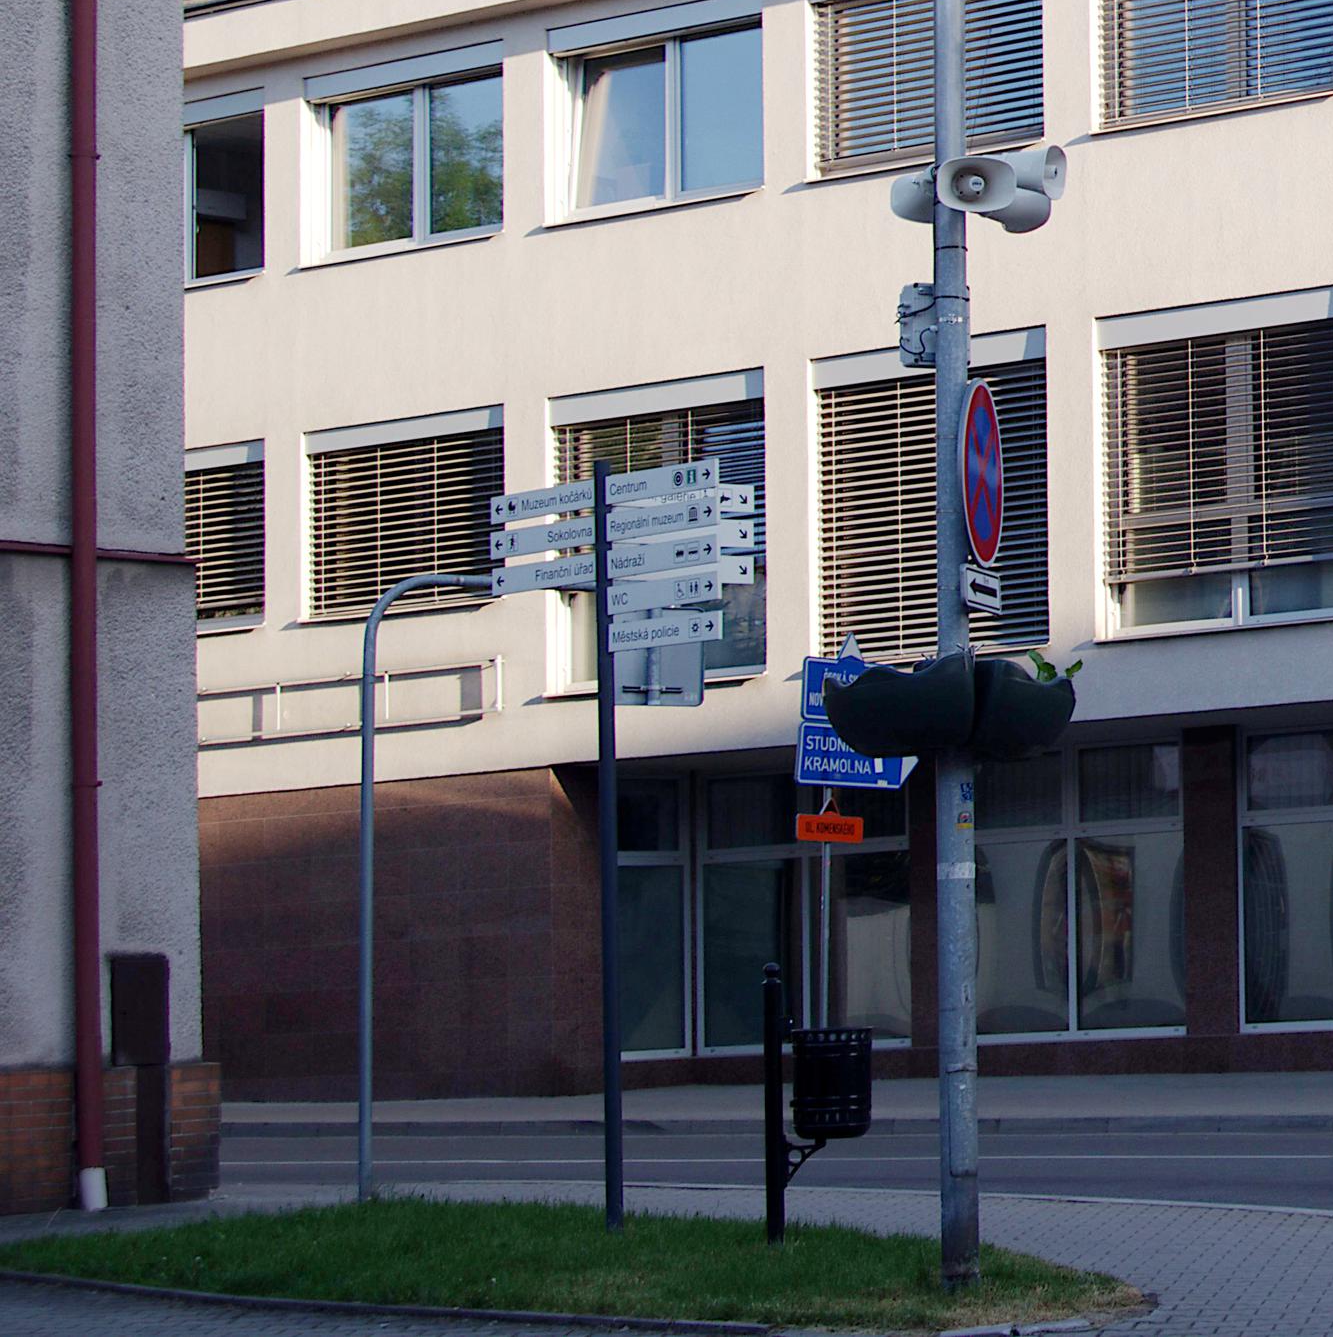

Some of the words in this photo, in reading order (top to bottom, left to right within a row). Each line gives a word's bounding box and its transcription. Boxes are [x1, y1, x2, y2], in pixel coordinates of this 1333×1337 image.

[609, 479, 648, 496] Centrum
[521, 496, 558, 512] Muzeum
[559, 487, 593, 504] kočárků
[610, 517, 650, 535] Regionální
[651, 511, 684, 527] muzeum
[547, 526, 593, 543] Sokolovna
[535, 565, 572, 583] Finanční
[573, 561, 594, 577] úřad
[610, 554, 646, 571] Nádraží
[611, 593, 629, 607] WC
[612, 626, 649, 644] Městská
[651, 624, 680, 641] policie
[803, 755, 872, 776] KRAMOLNA
